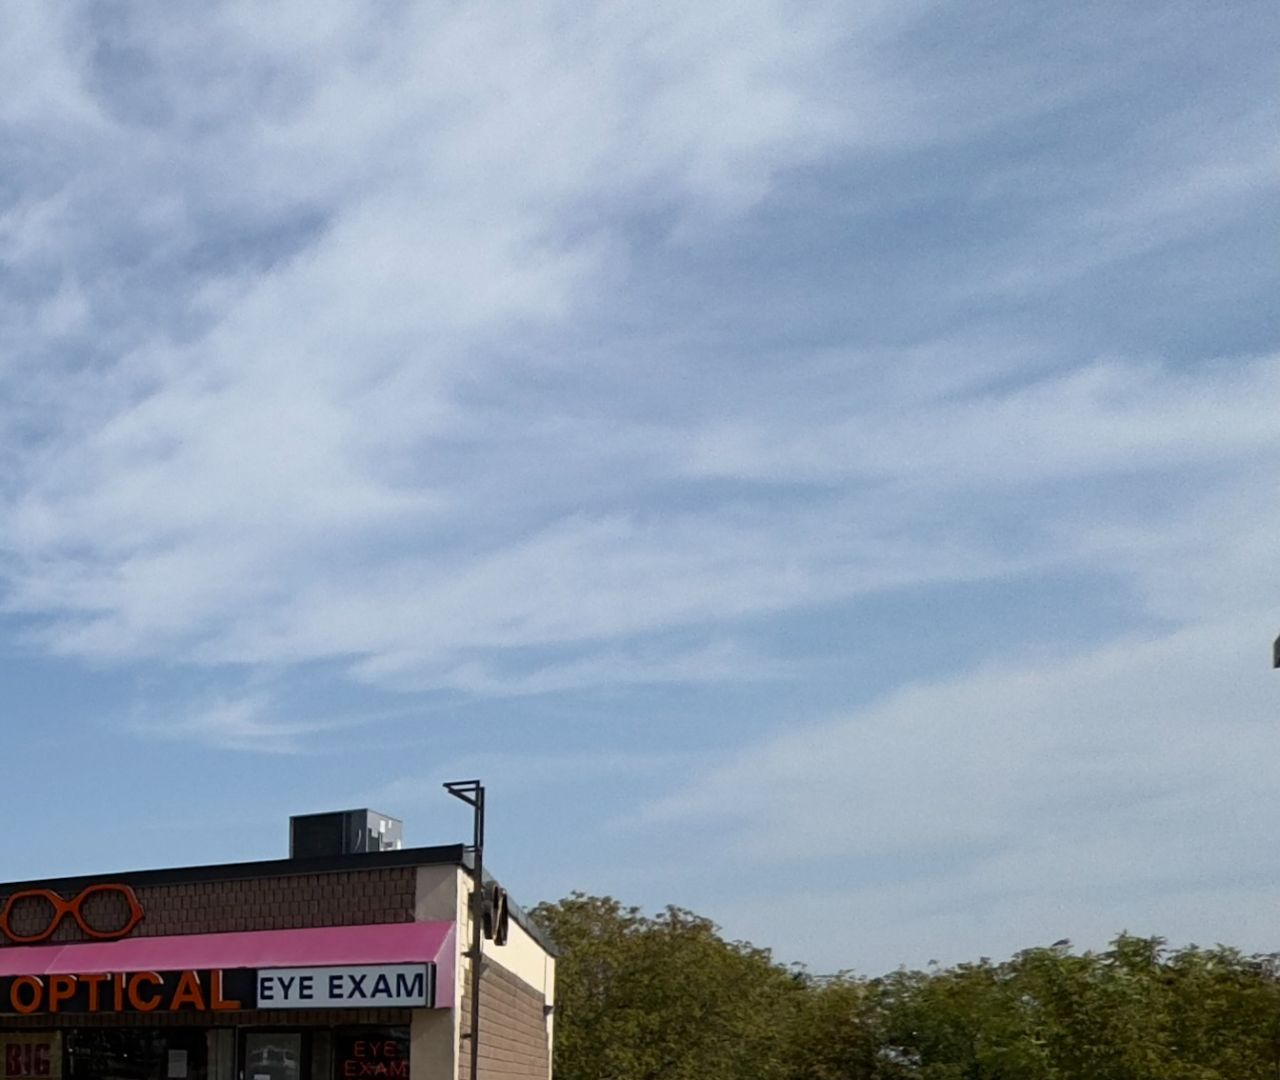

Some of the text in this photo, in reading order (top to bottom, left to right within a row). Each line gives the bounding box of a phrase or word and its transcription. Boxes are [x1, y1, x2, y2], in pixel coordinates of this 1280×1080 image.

[10, 969, 241, 1014] OPTICAL
[259, 973, 425, 1001] EYE EXAM
[5, 1043, 52, 1076] BIG
[353, 1040, 397, 1057] EYE
[344, 1059, 410, 1078] EXAM
